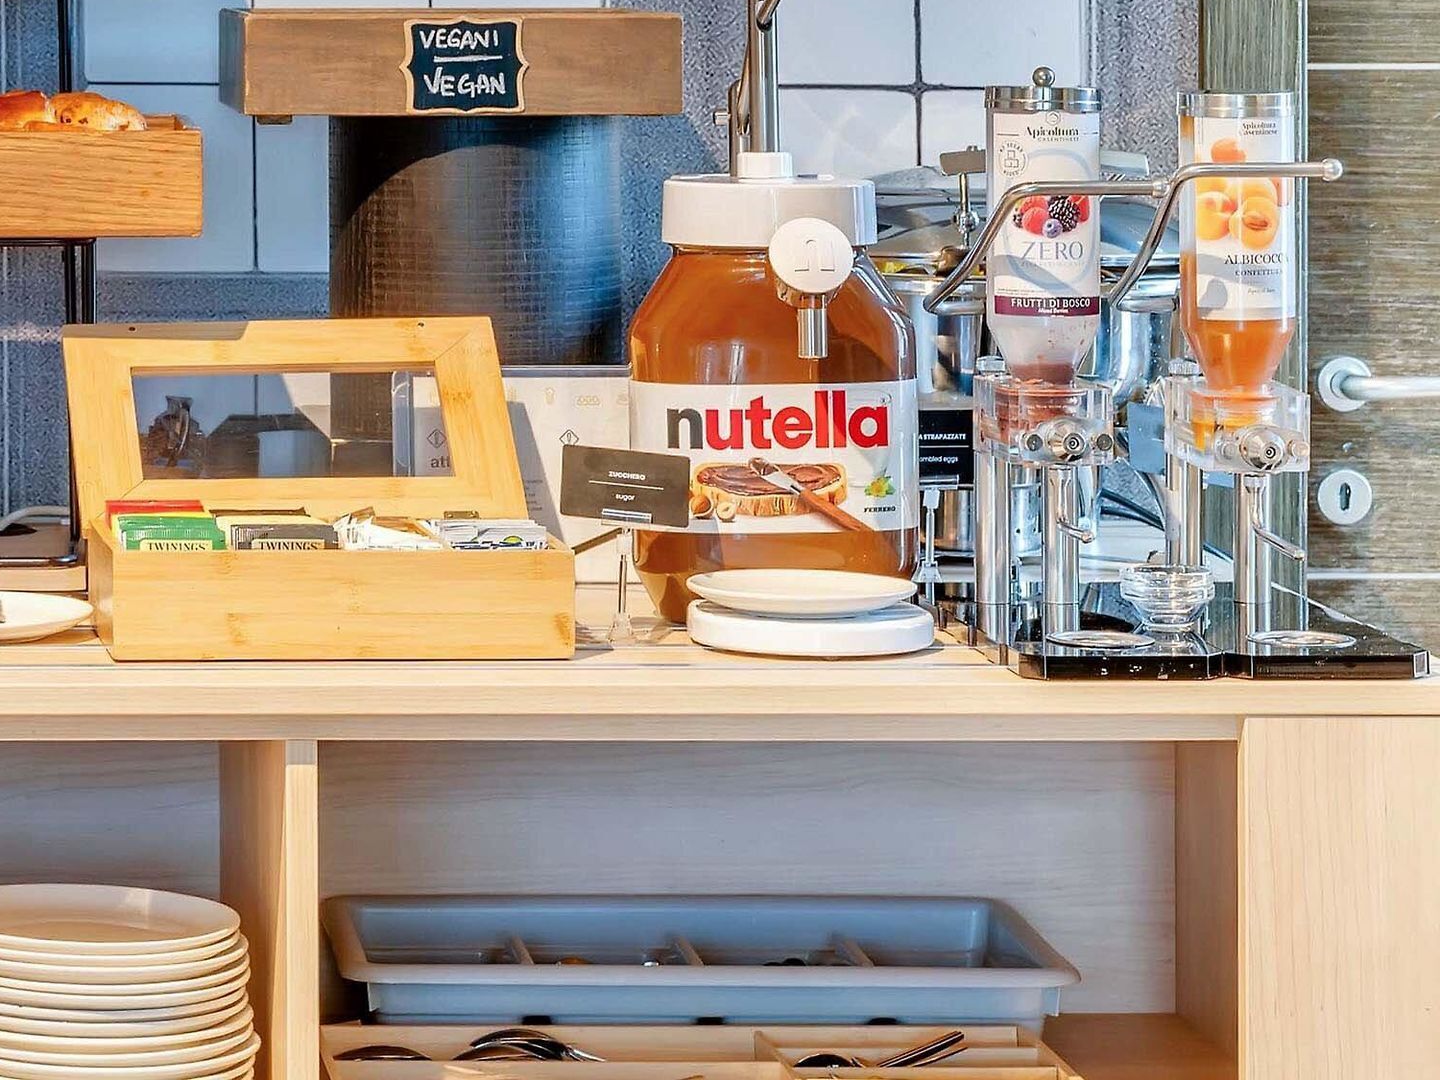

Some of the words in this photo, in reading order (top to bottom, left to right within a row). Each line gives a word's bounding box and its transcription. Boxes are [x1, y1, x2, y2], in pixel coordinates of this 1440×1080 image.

[419, 28, 499, 50] VEGANI
[423, 66, 506, 98] VEGAN
[1021, 241, 1083, 260] ZERO
[1011, 298, 1046, 308] FRUTTI
[1049, 299, 1060, 308] DI
[1063, 298, 1090, 308] BOSCO
[666, 390, 888, 450] nutella
[608, 470, 646, 481] ZUCCHERO
[615, 493, 636, 501] sugar
[147, 541, 208, 551] TWININGS
[259, 540, 319, 550] TWININGS
